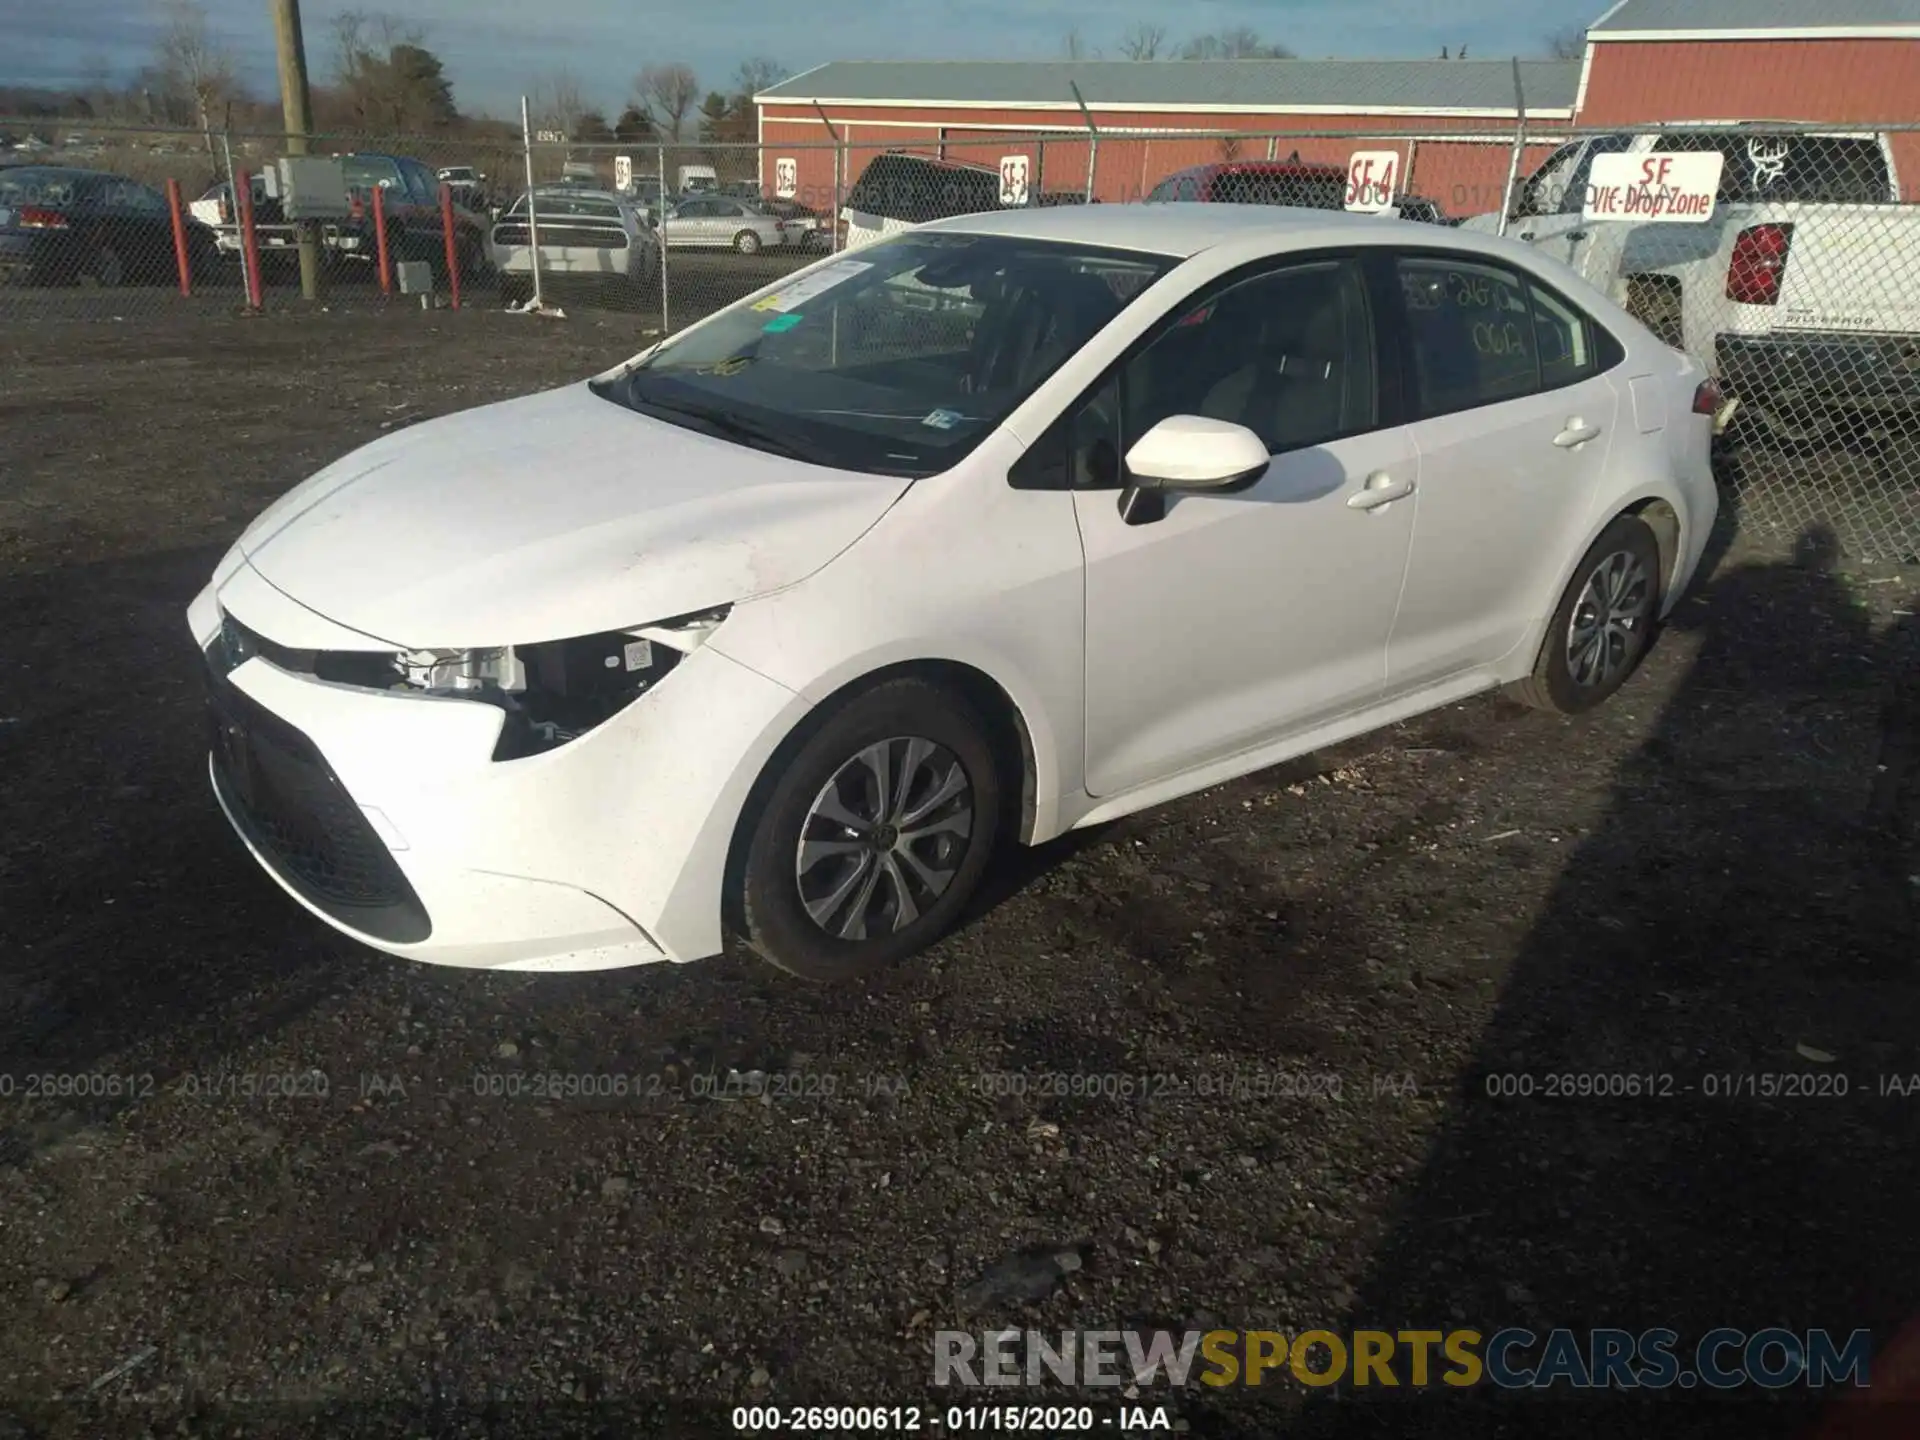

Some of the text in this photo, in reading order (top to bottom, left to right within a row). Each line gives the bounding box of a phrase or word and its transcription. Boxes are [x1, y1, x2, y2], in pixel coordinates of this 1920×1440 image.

[1348, 159, 1394, 202] SF-4
[1638, 157, 1674, 185] SF
[1665, 187, 1710, 214] Zone
